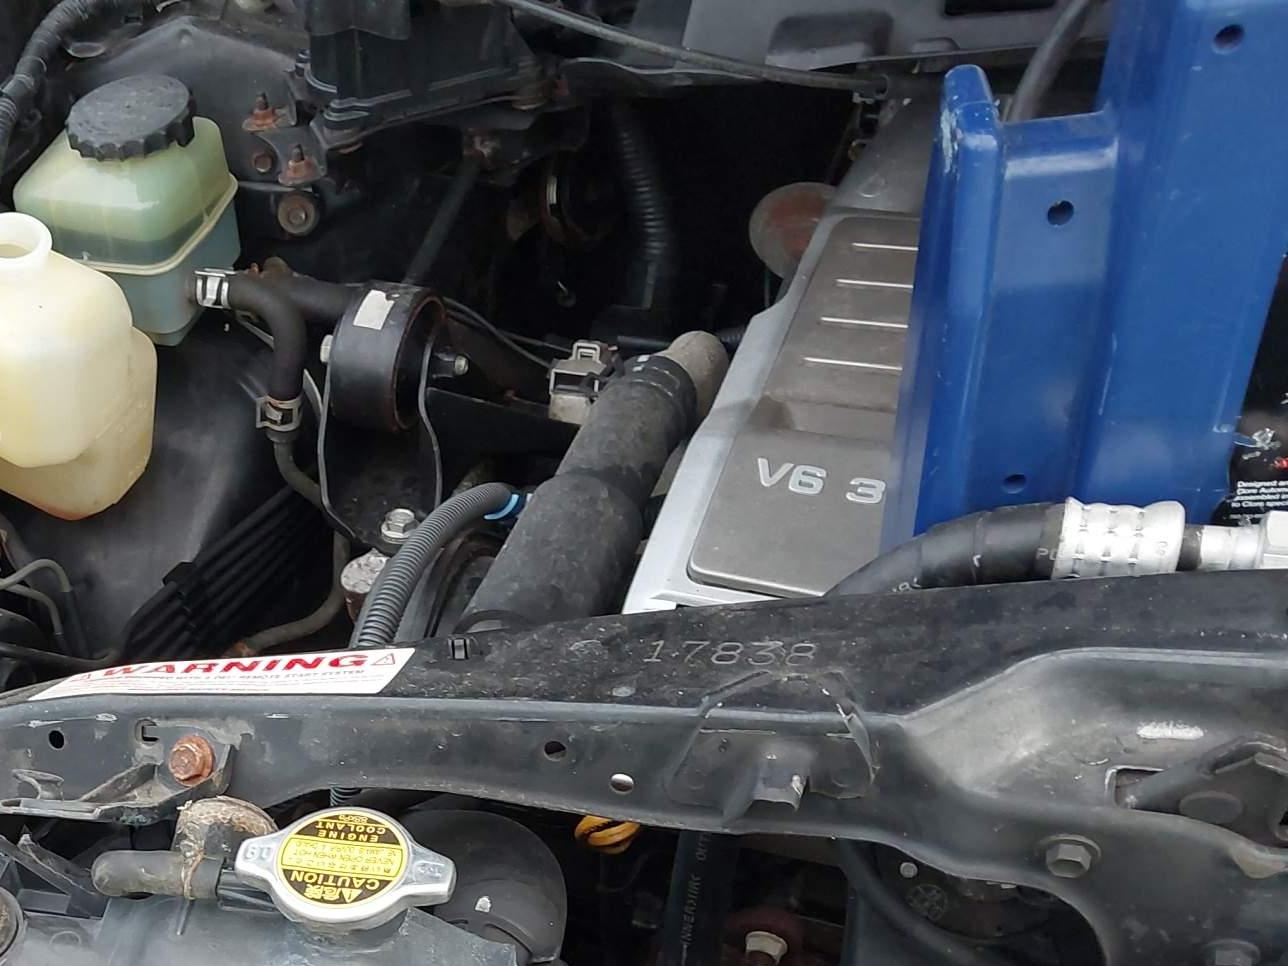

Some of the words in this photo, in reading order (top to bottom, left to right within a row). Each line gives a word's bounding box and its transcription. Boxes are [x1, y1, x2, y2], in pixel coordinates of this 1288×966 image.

[757, 457, 828, 495] V6
[643, 639, 819, 667] 17838
[103, 655, 368, 677] WARNING
[315, 820, 386, 835] COOLANT
[318, 829, 379, 842] ENGINE
[290, 870, 380, 890] CAUTION
